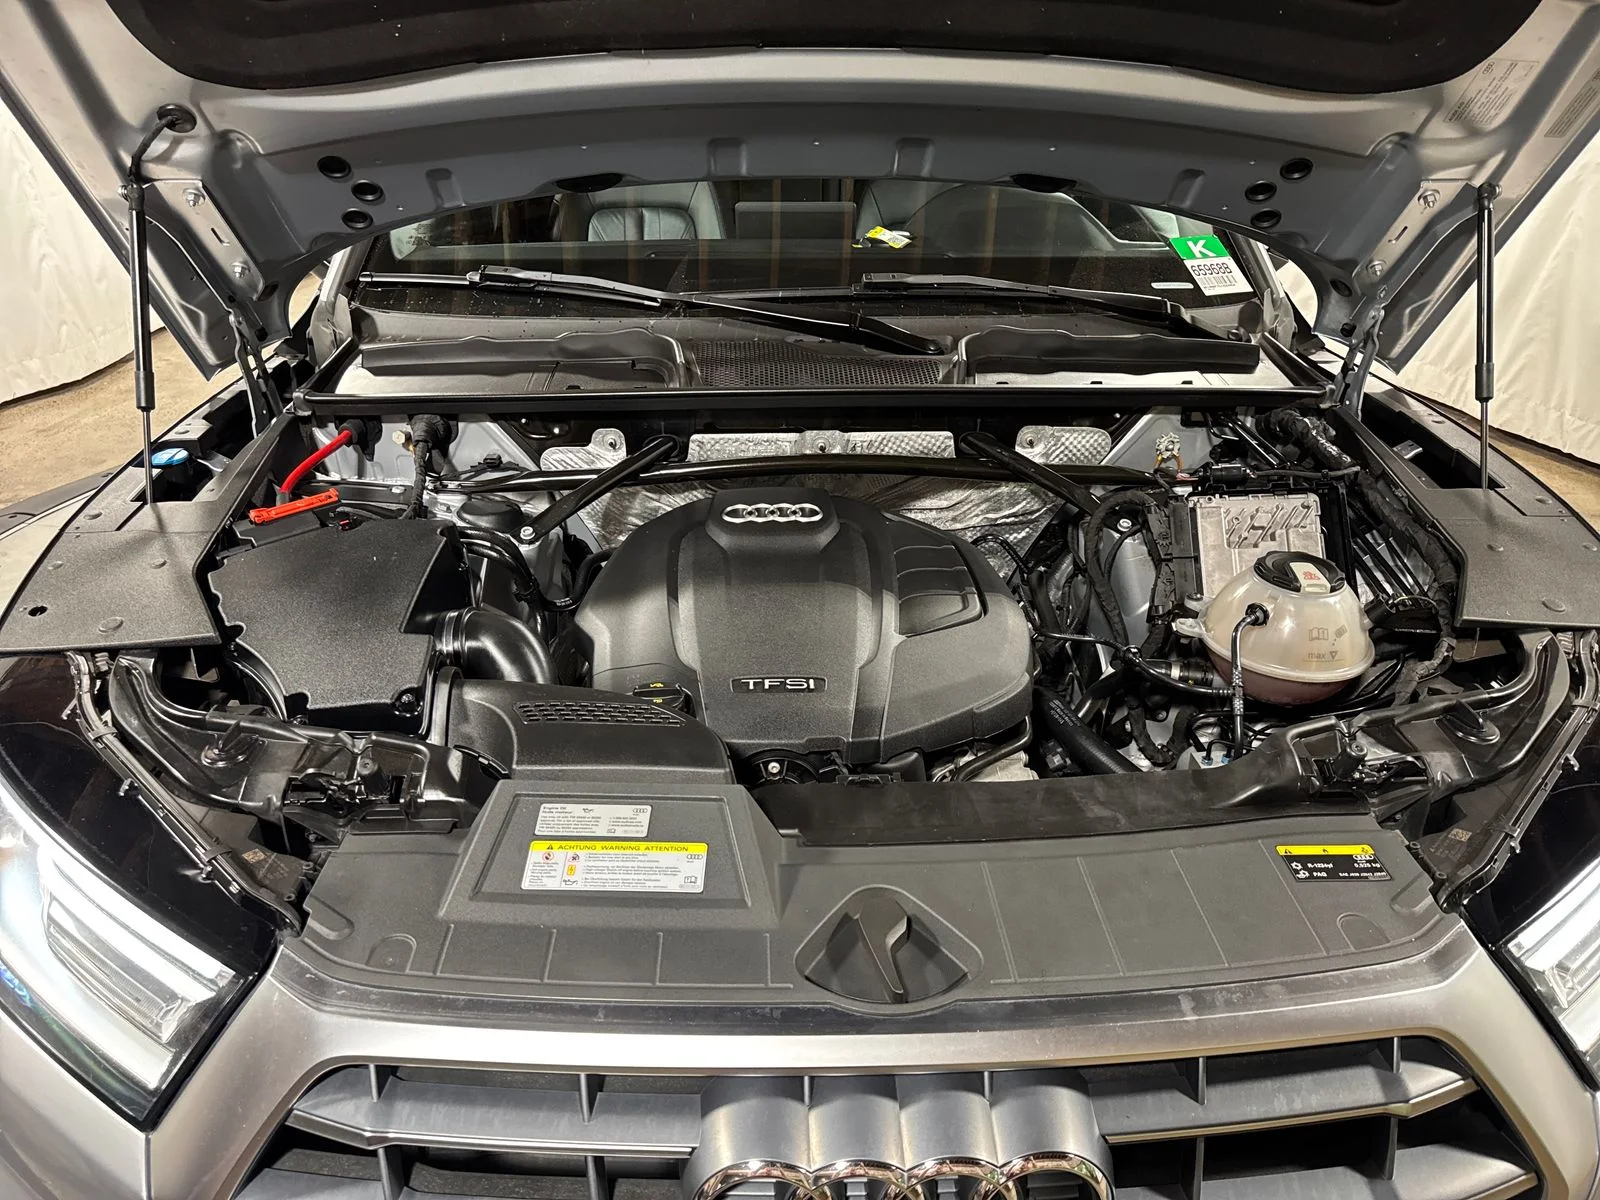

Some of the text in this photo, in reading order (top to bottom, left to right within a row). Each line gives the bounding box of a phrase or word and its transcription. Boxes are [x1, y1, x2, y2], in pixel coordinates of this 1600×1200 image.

[1186, 239, 1217, 258] K
[1190, 262, 1233, 277] 65968B
[1307, 652, 1326, 660] max
[741, 678, 815, 690] TFSI
[557, 844, 689, 853] ACHTUNG WARNING ATTENTION
